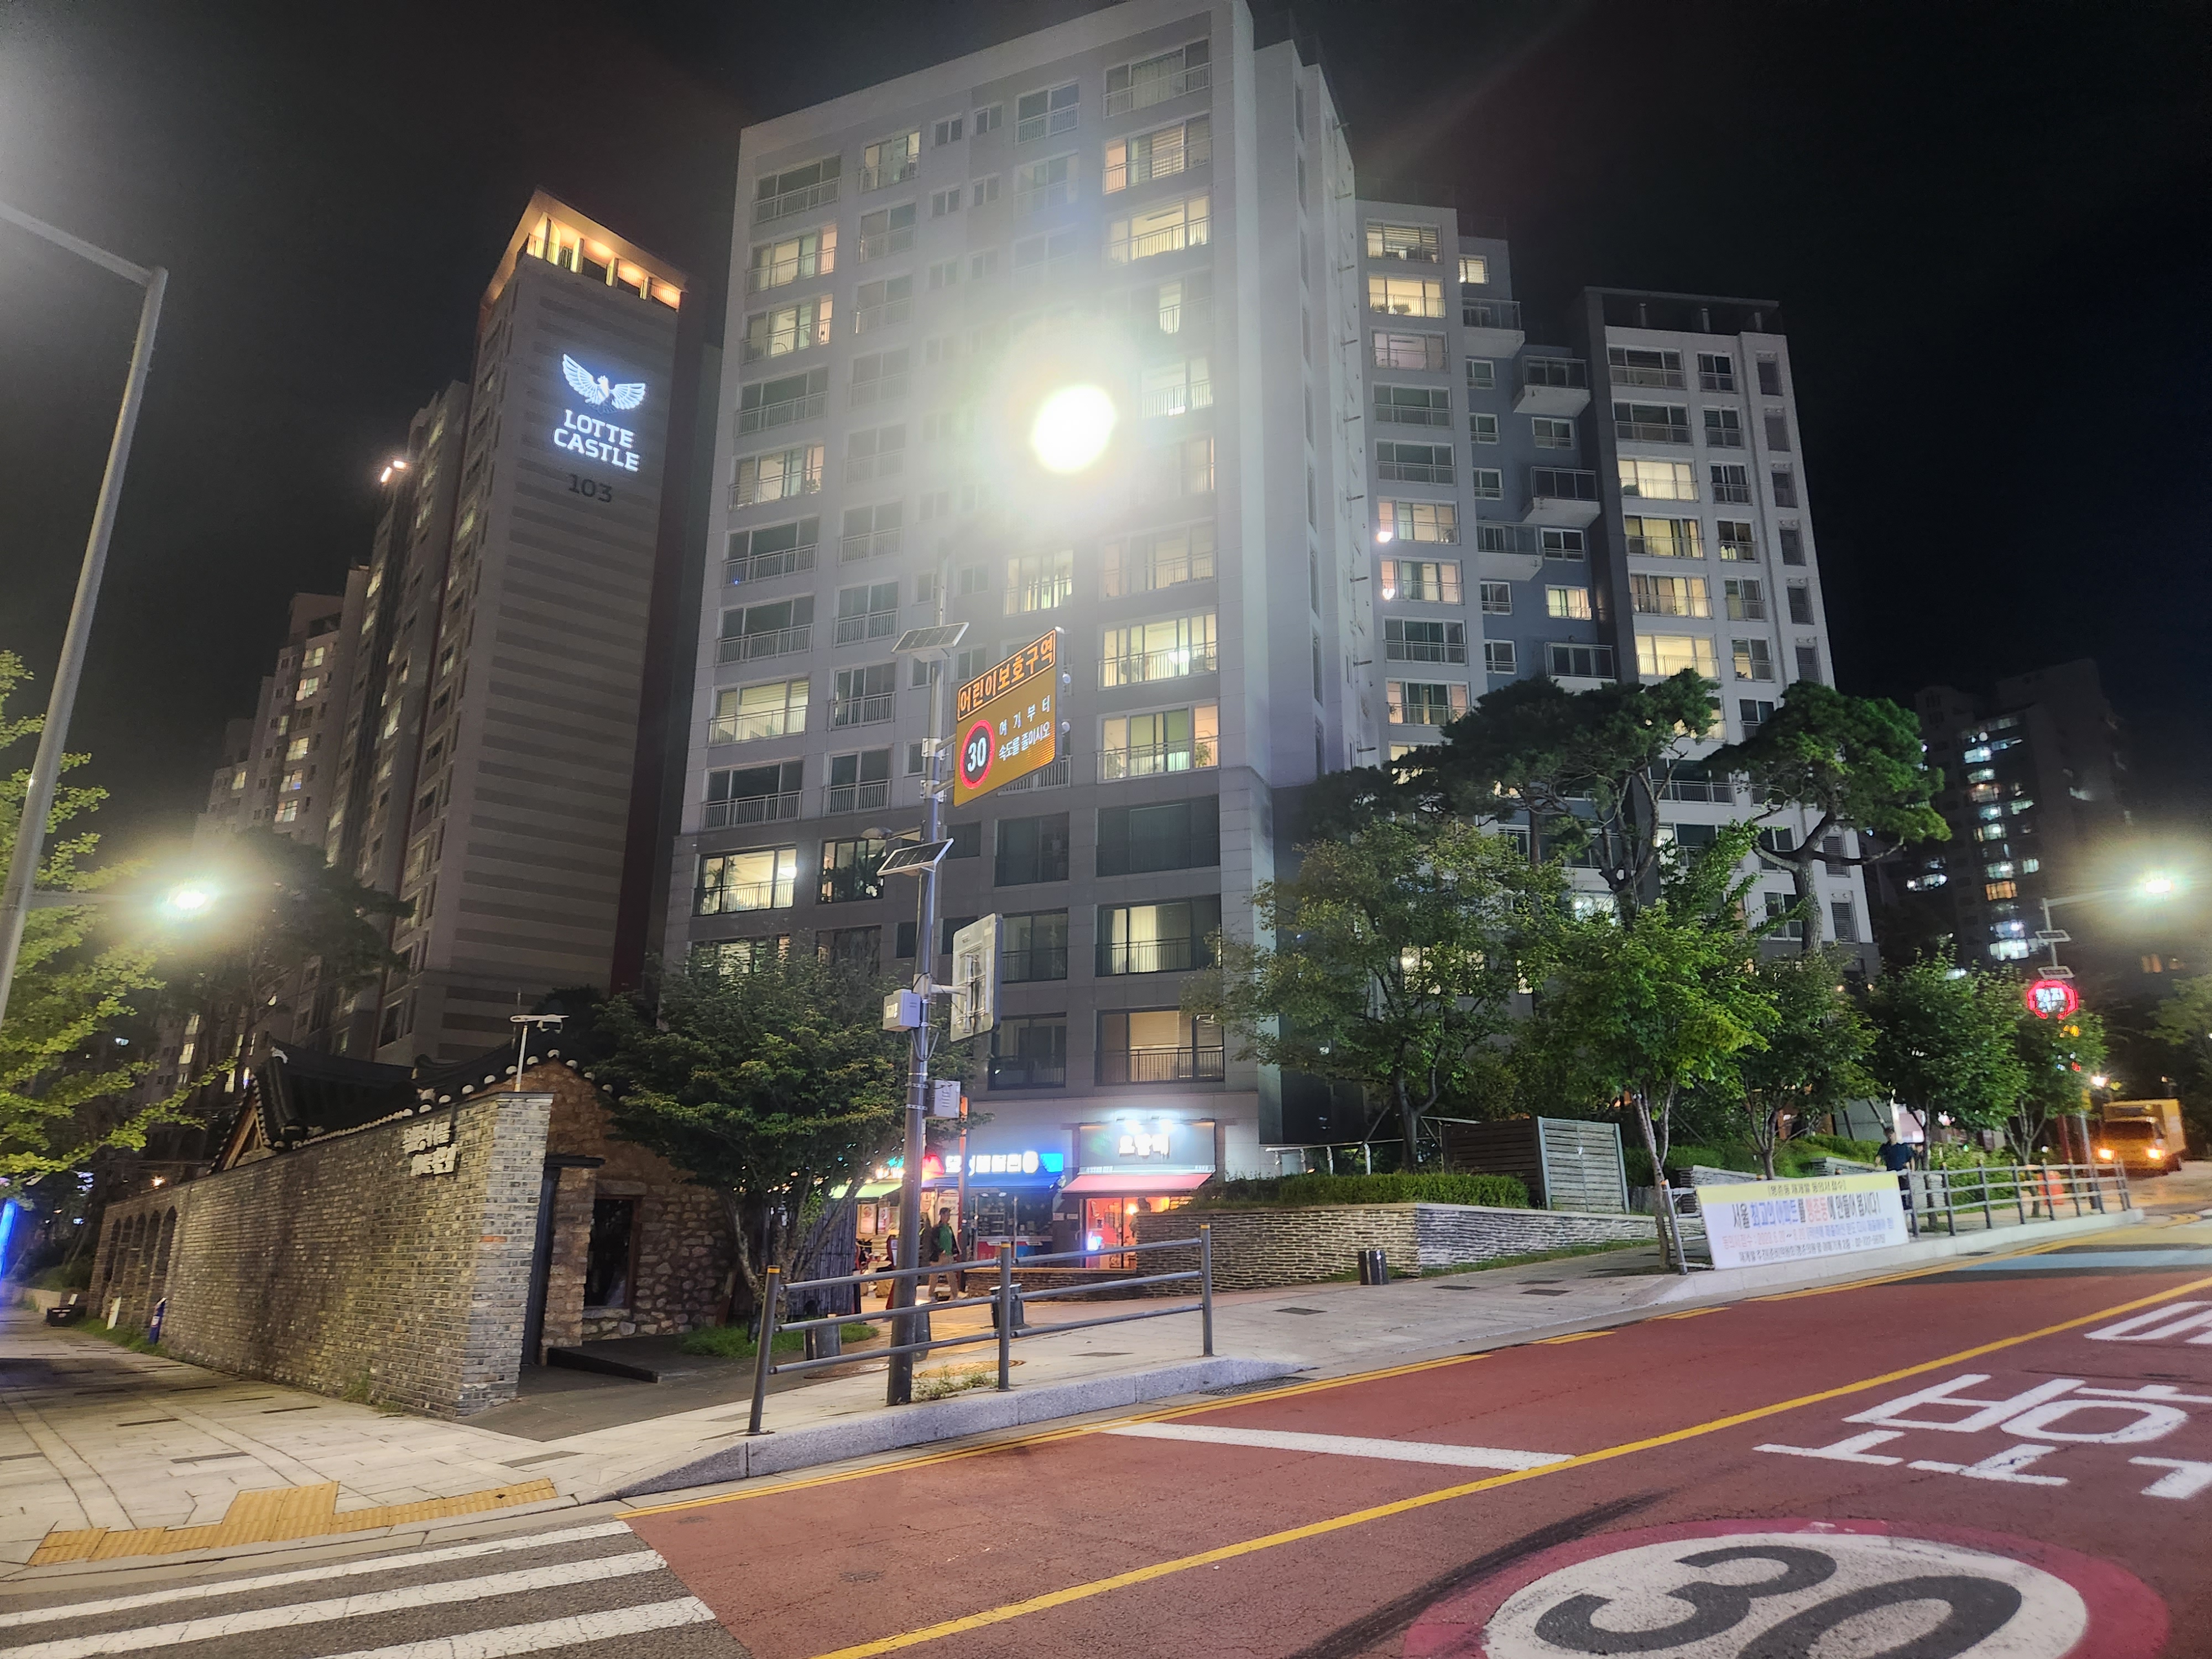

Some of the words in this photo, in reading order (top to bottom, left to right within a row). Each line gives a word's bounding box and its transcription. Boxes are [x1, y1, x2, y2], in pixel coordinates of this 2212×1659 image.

[564, 409, 634, 448] LOTTE
[554, 428, 640, 472] CASTLE
[568, 473, 612, 503] 103
[960, 635, 1053, 712] 어린이보호구역
[967, 737, 987, 773] 30
[999, 736, 1020, 761] 속도를
[1021, 721, 1050, 752] 줄이시오
[1731, 1202, 1750, 1229] 서울
[1535, 1545, 2022, 1659] 30
